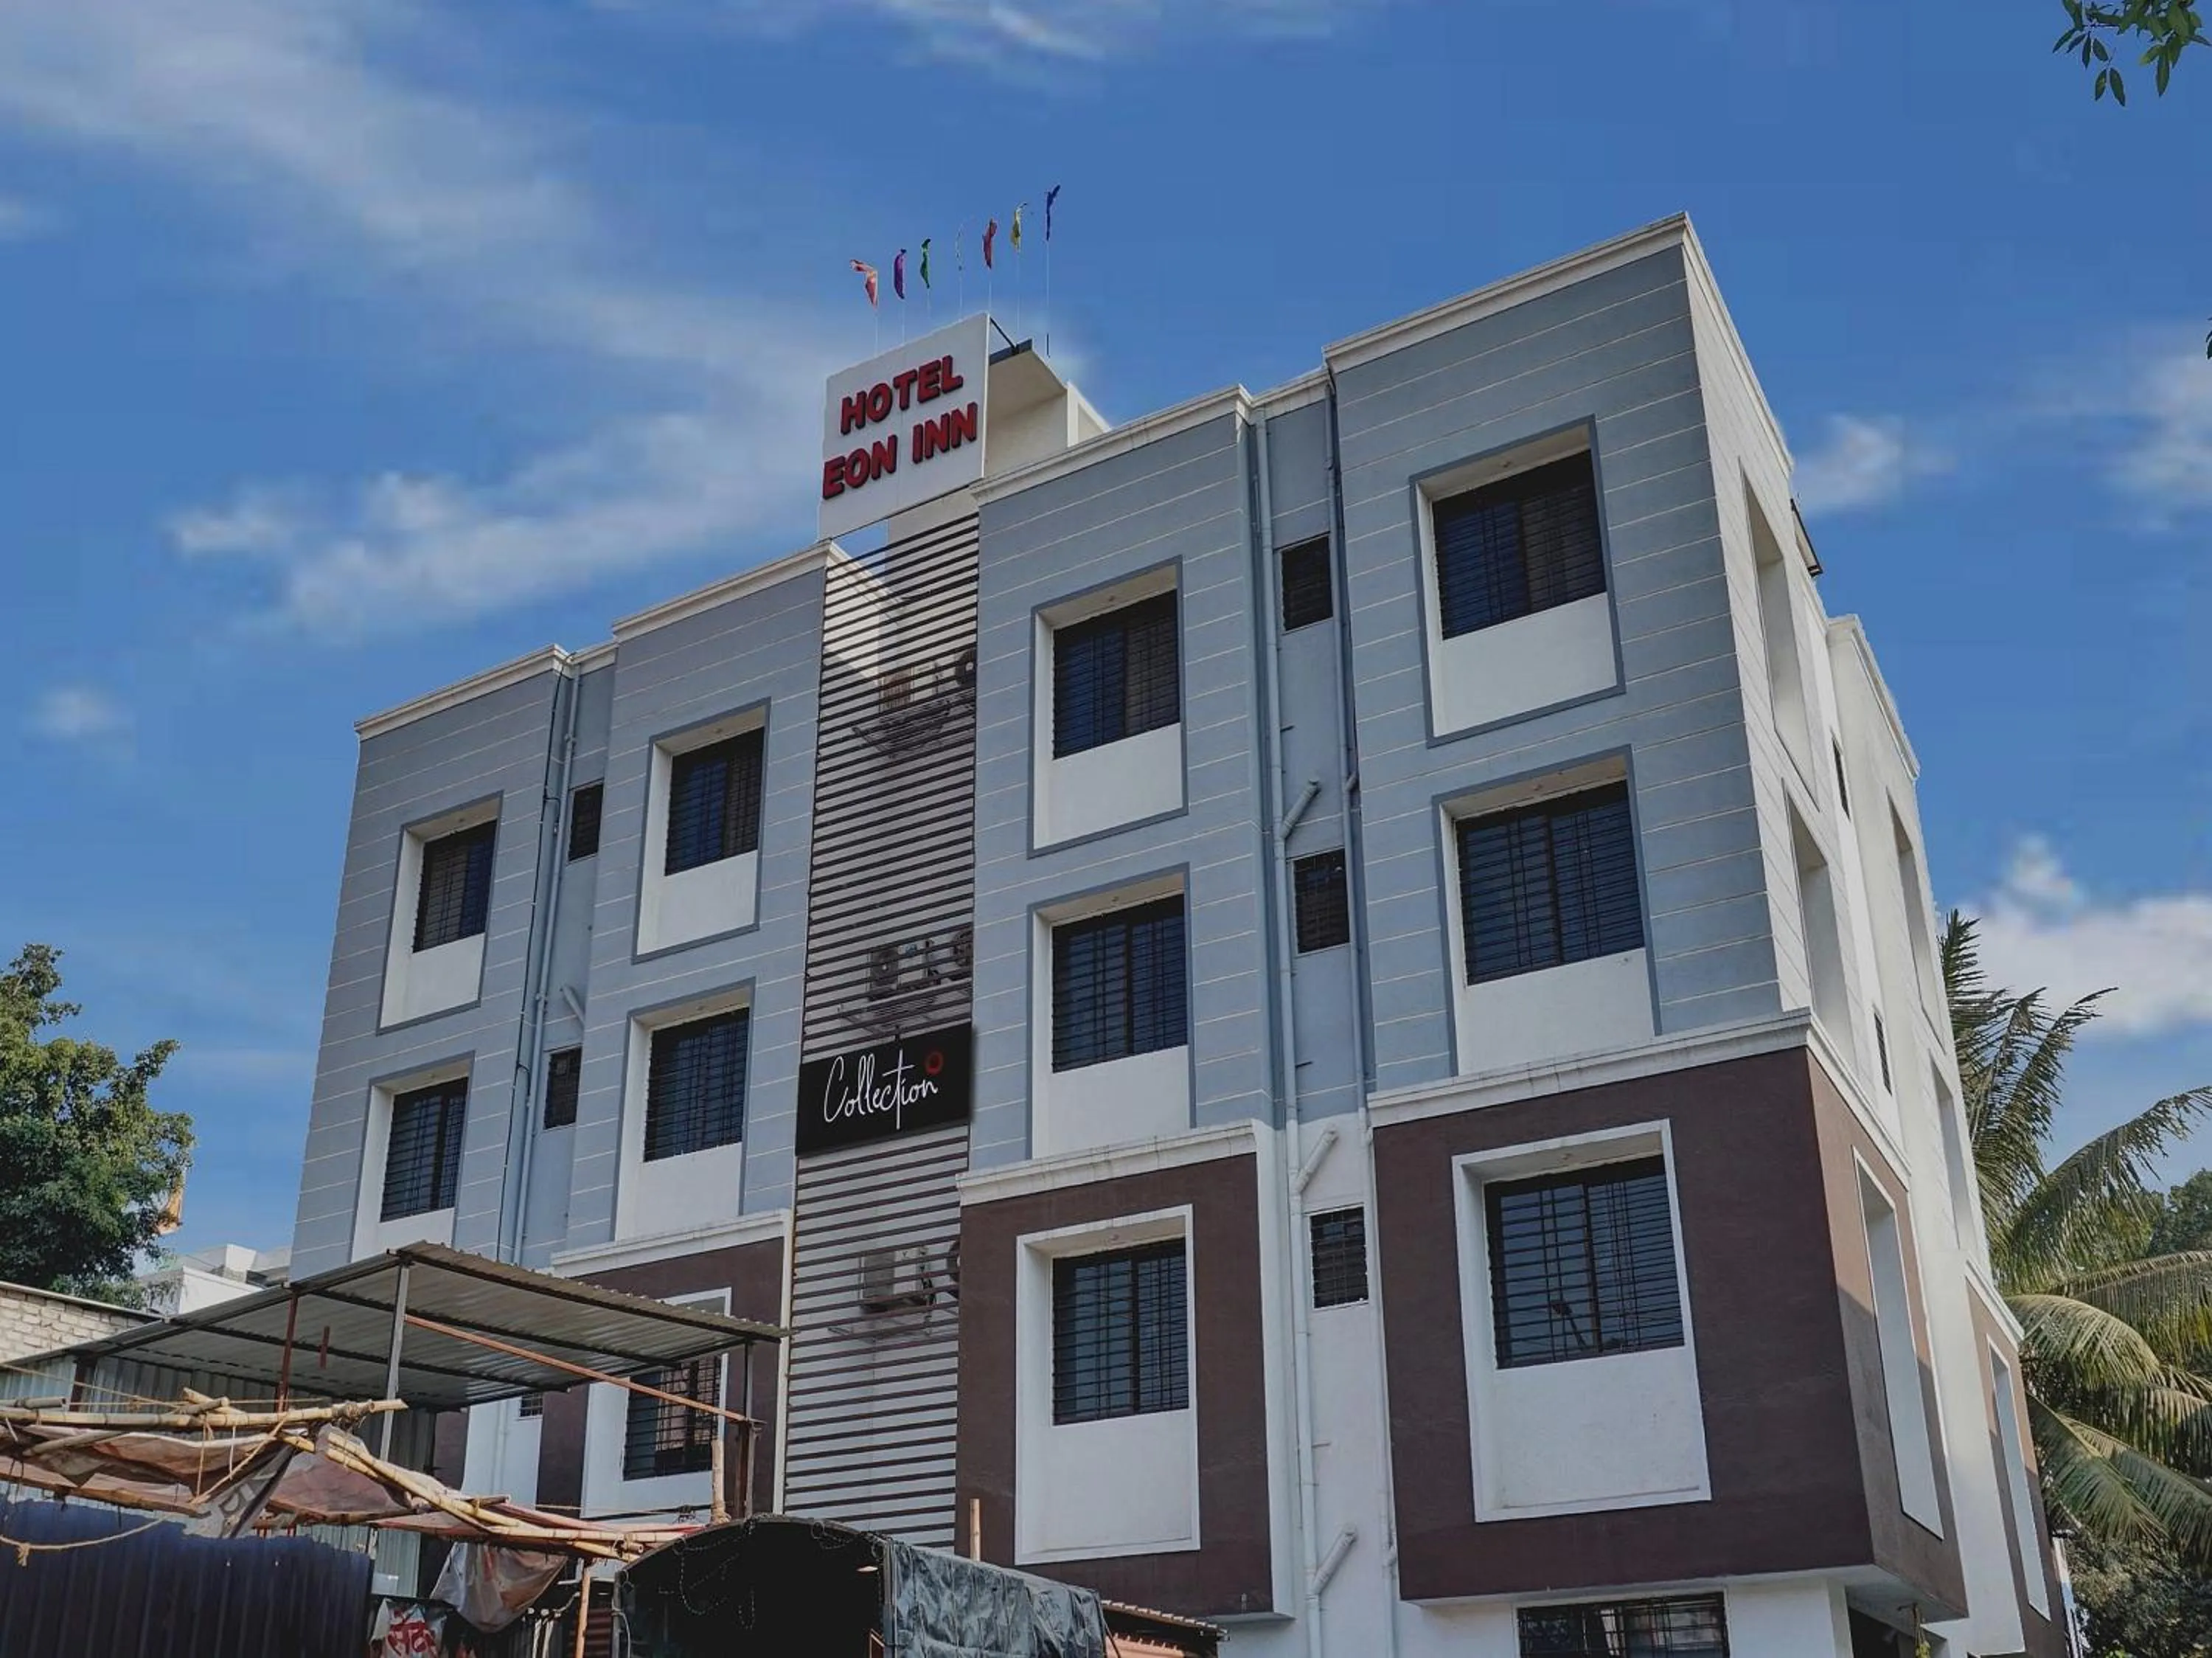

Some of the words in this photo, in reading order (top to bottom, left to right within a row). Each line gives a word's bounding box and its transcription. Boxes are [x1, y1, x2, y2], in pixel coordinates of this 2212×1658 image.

[841, 355, 963, 435] HOTEL
[822, 434, 897, 499] EON
[912, 402, 978, 464] INN
[824, 1049, 938, 1130] Collection
